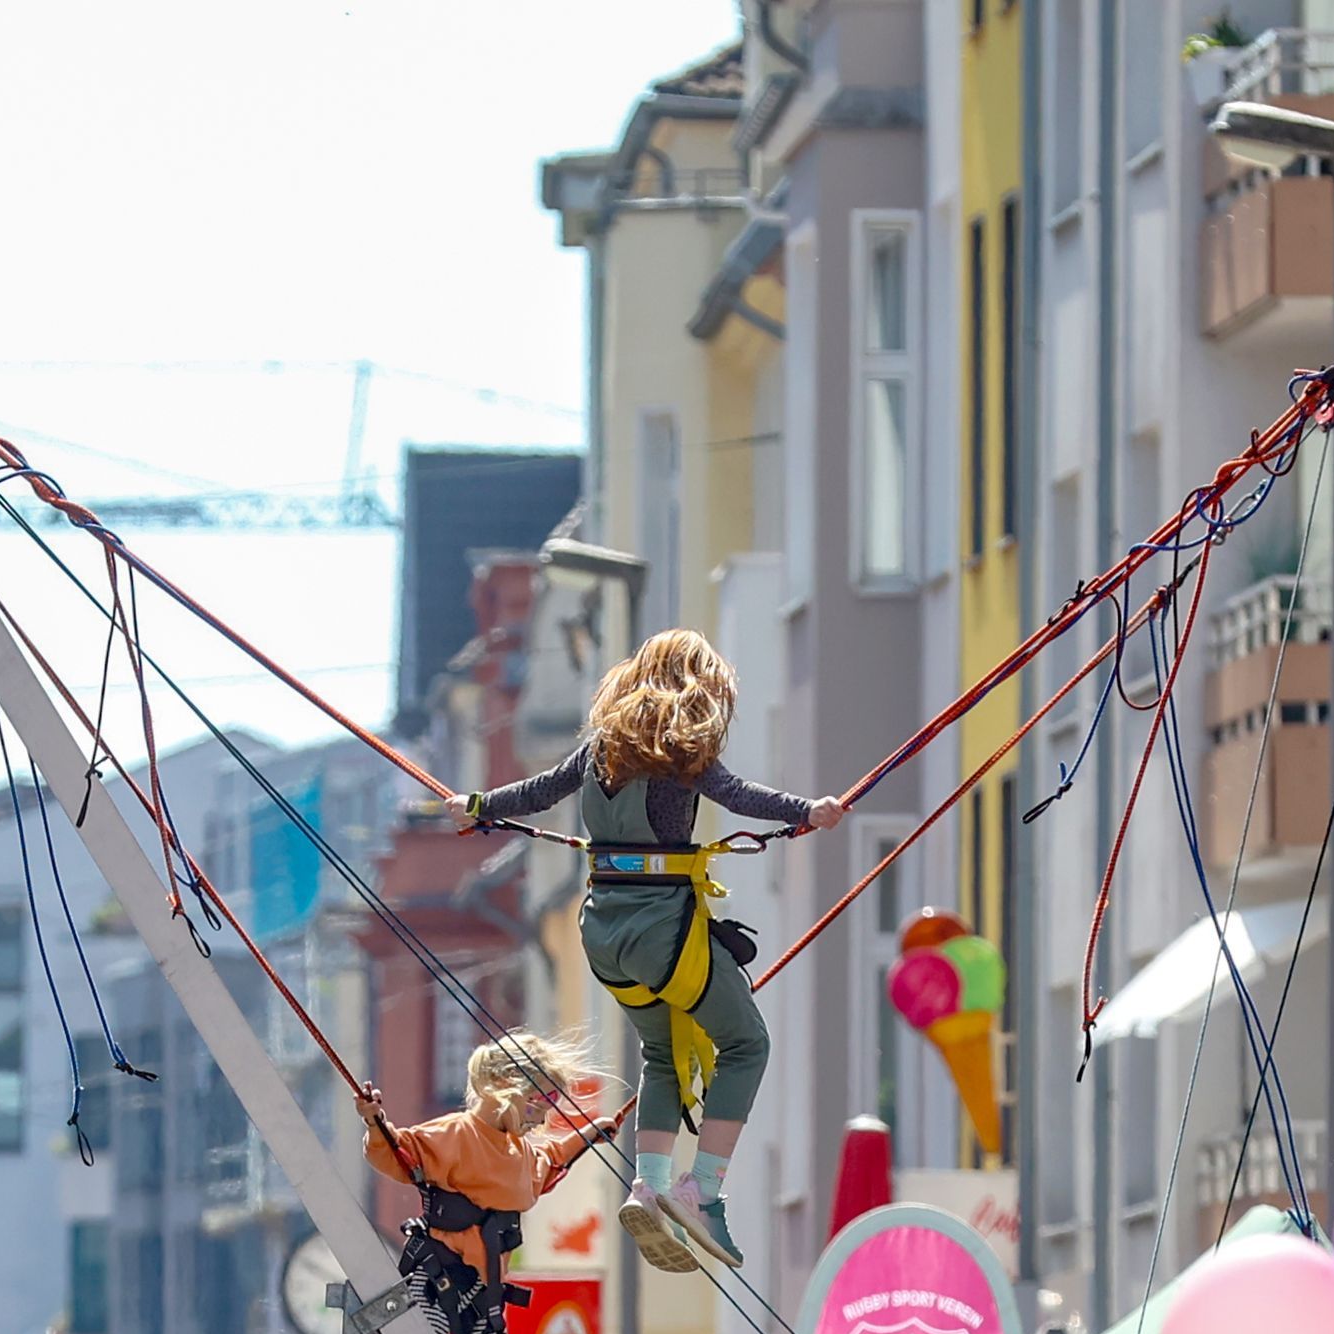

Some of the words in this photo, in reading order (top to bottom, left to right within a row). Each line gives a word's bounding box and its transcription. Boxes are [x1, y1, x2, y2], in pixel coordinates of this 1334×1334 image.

[842, 1291, 890, 1322] RUGBY
[891, 1289, 937, 1308] SPORT
[937, 1294, 984, 1329] VEREIN
